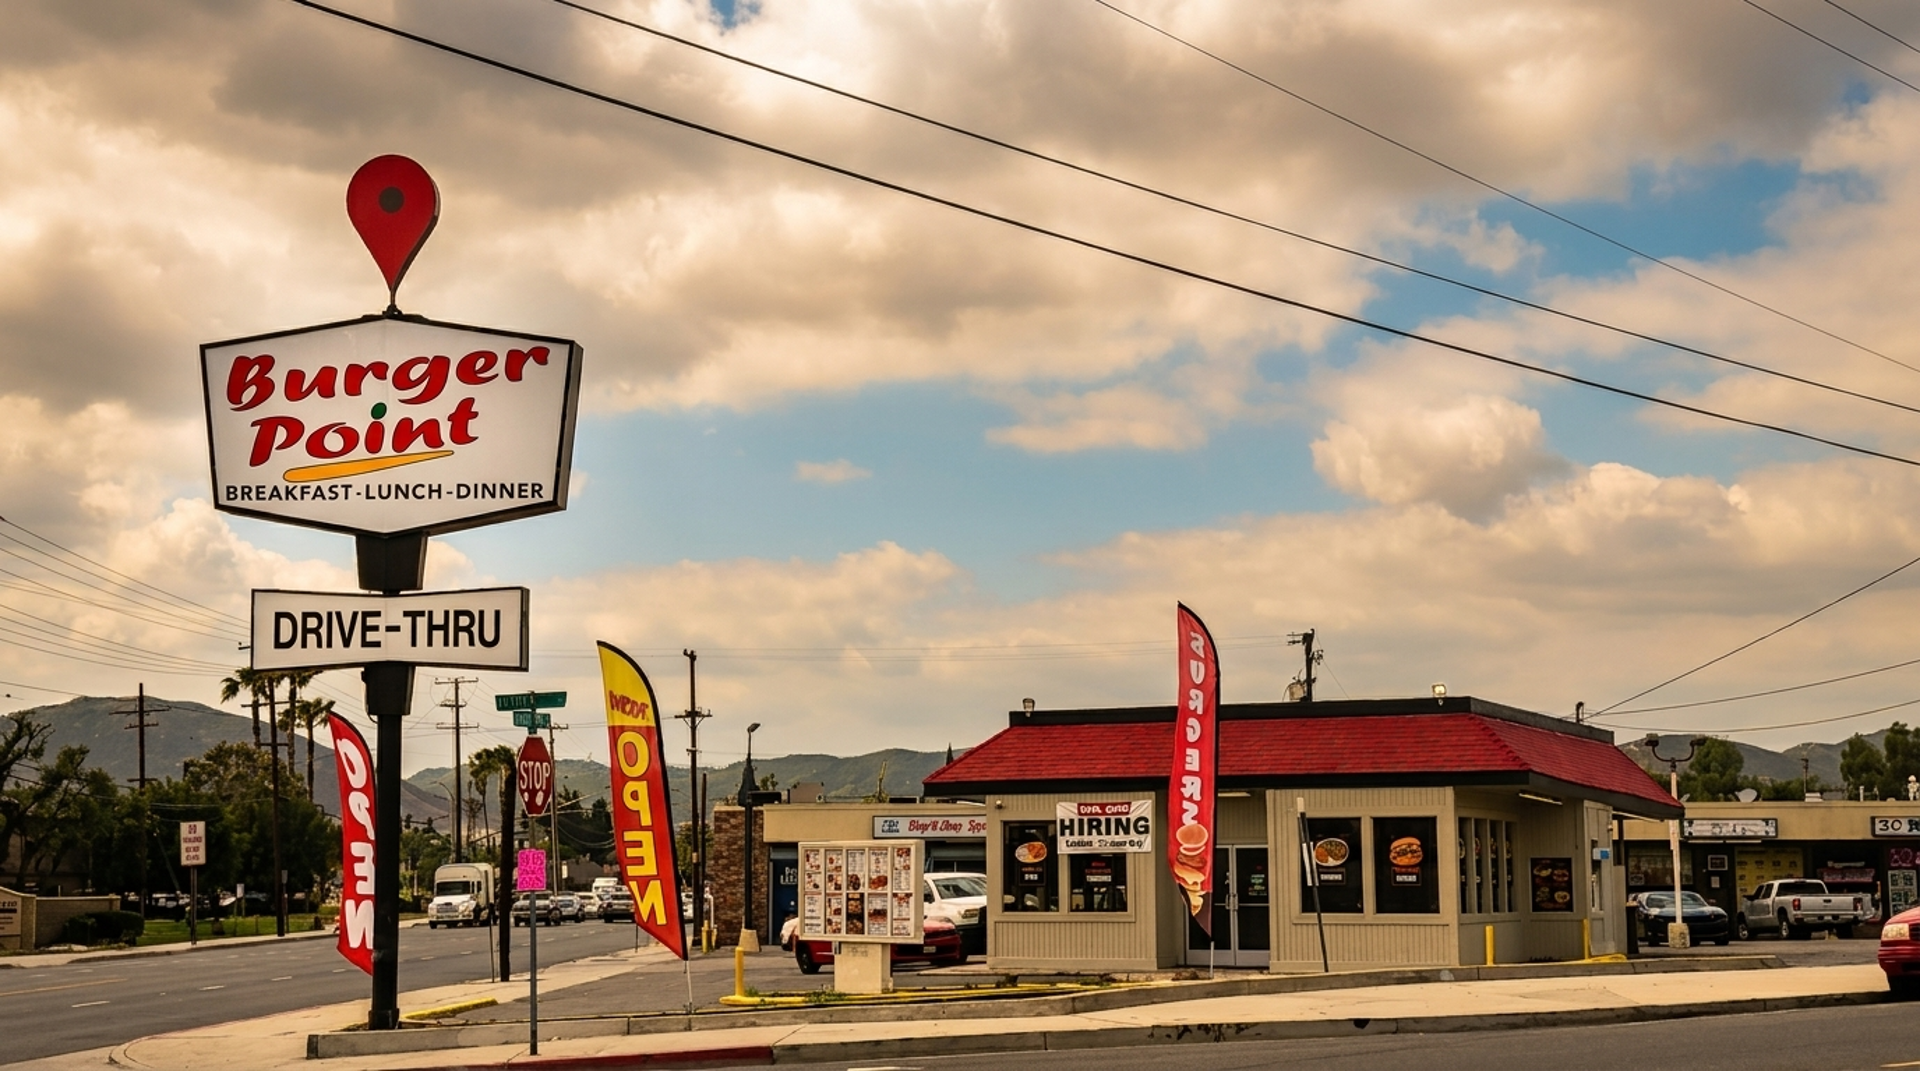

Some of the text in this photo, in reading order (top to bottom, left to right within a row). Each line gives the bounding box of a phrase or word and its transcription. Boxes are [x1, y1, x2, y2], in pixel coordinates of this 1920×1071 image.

[226, 346, 550, 411] Burger
[249, 397, 479, 467] Point
[273, 609, 501, 649] DRIVE-THRU
[520, 761, 551, 790] STOP
[1059, 816, 1150, 836] HIRING
